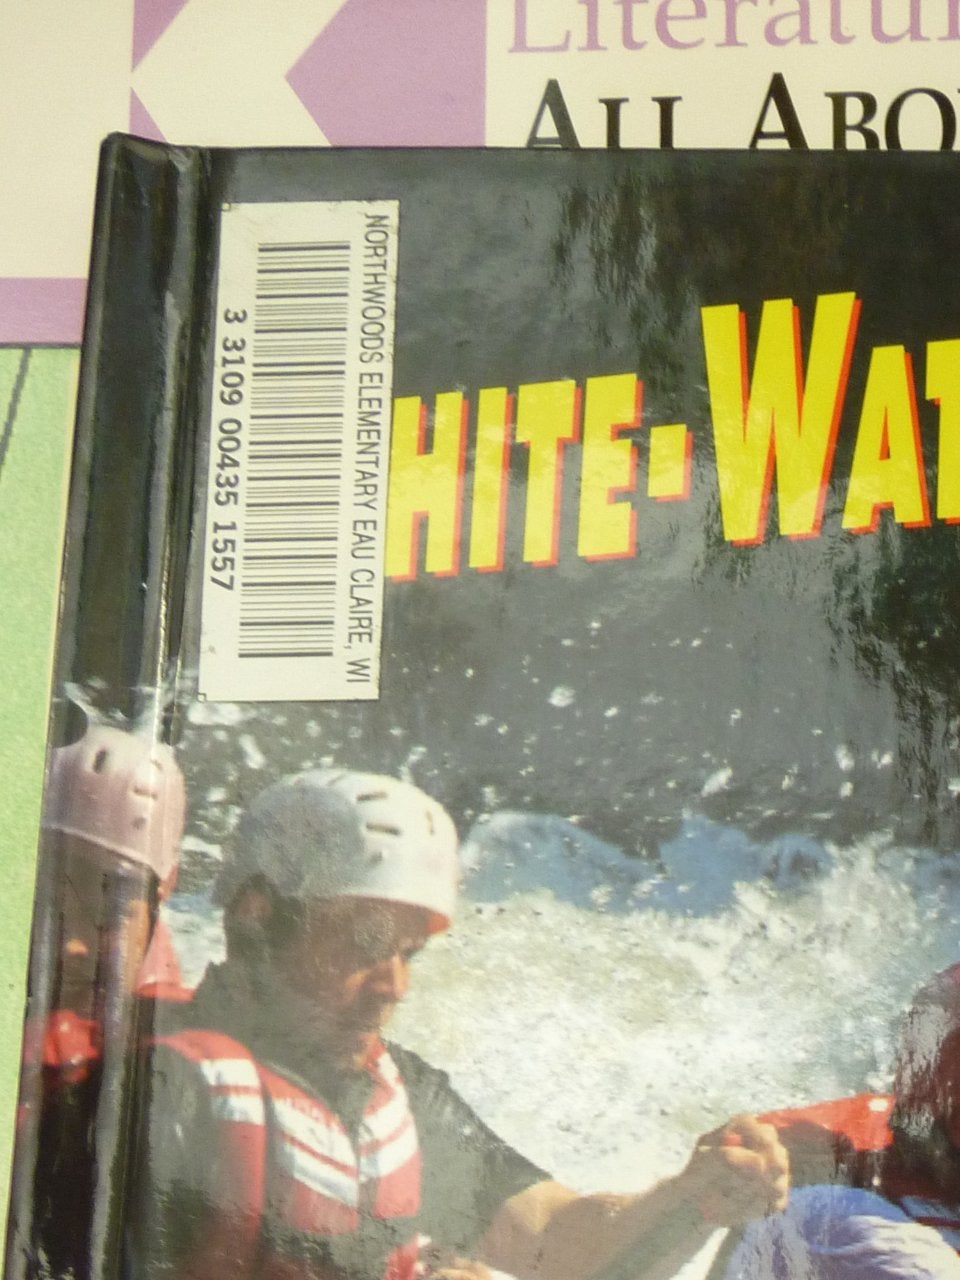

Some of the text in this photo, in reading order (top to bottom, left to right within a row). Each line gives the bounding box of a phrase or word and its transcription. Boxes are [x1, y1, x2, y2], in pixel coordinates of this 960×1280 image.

[209, 307, 248, 591] 3 3109 00435 1557
[343, 213, 390, 683] NORTHWOODS ELEMENTARY EAU CLAIRE, WI
